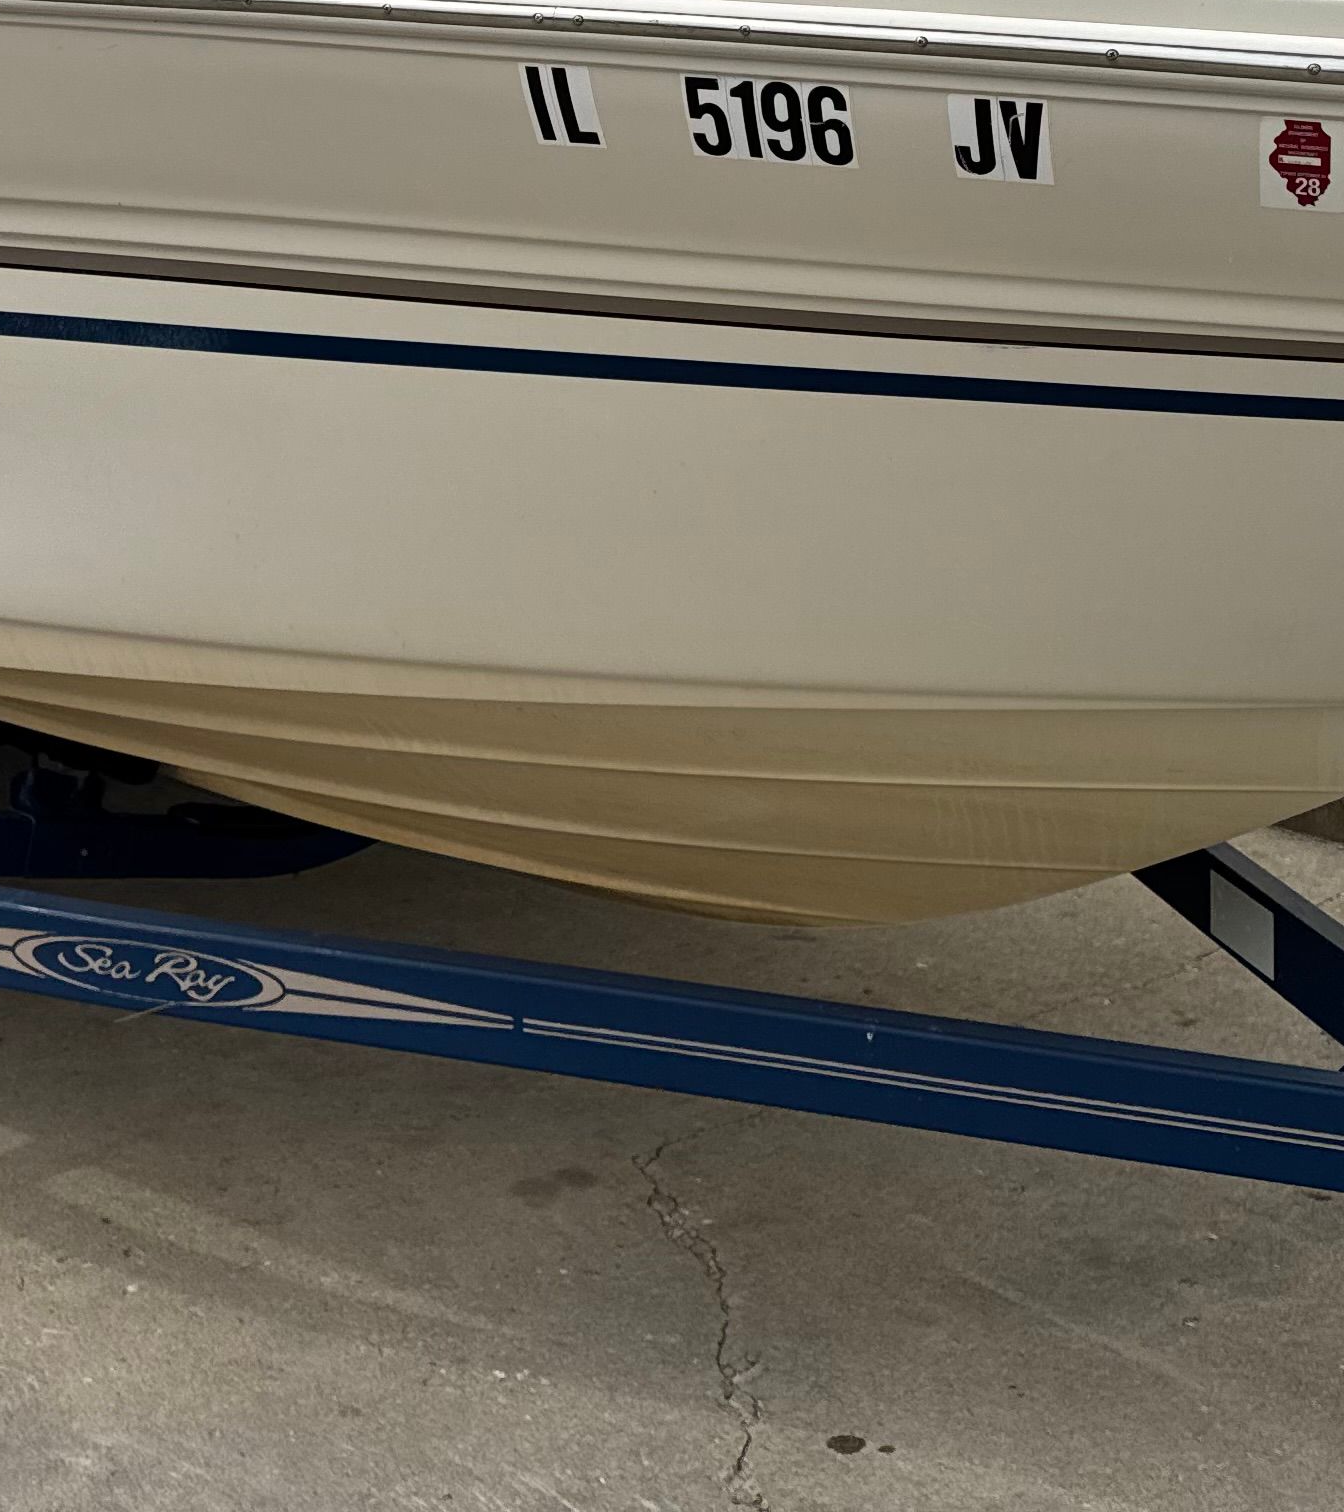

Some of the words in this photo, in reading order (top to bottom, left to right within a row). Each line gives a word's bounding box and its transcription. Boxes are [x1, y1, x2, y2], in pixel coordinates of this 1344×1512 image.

[524, 65, 601, 145] IL
[684, 76, 855, 166] 5196
[955, 97, 1043, 180] JV
[1295, 177, 1321, 196] 28
[57, 943, 142, 980] Sea
[144, 950, 236, 1002] Ray
